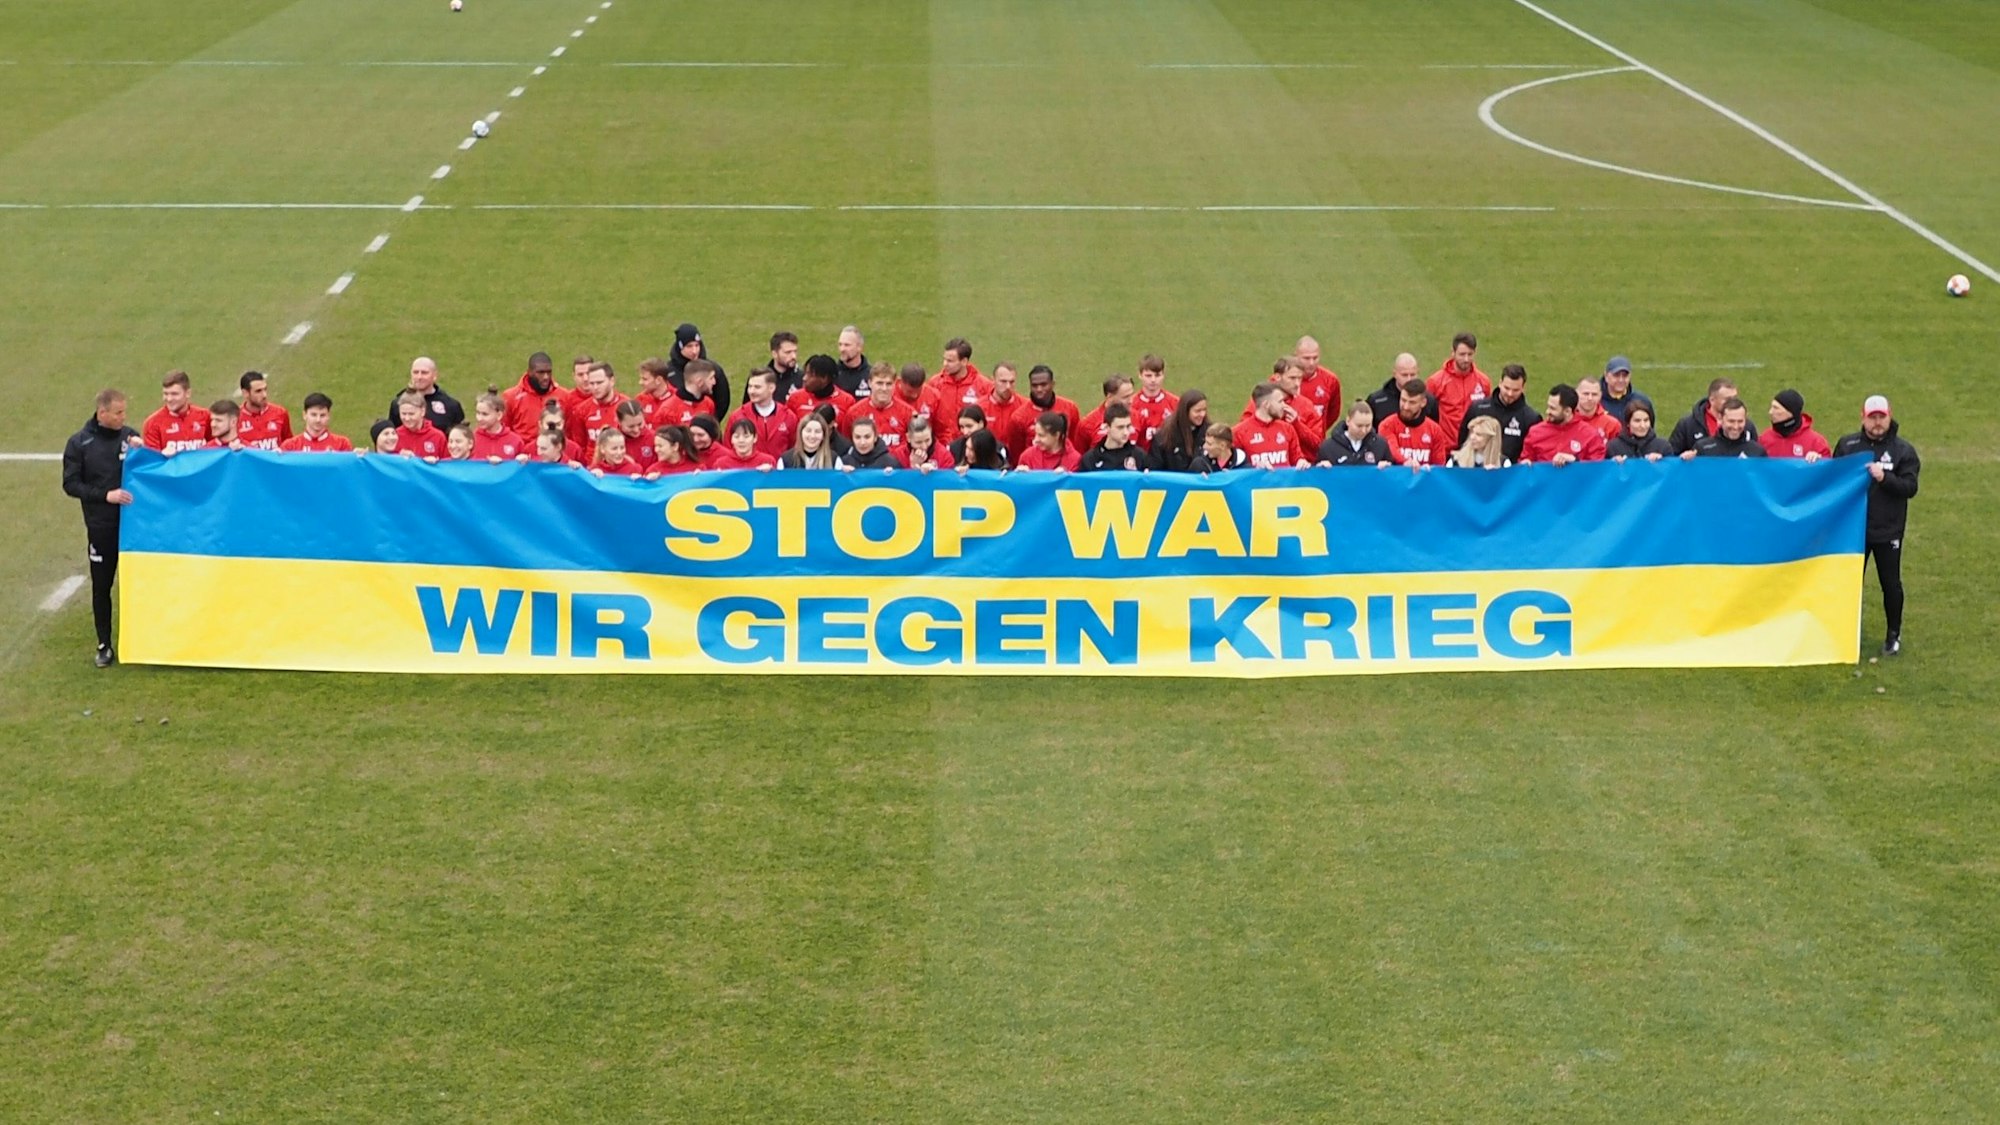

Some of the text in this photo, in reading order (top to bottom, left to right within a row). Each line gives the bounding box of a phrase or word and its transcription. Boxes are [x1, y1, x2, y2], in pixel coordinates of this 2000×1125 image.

[664, 487, 1330, 560] STOP WAR
[416, 586, 1572, 665] WIR GEGEN KRIEG
